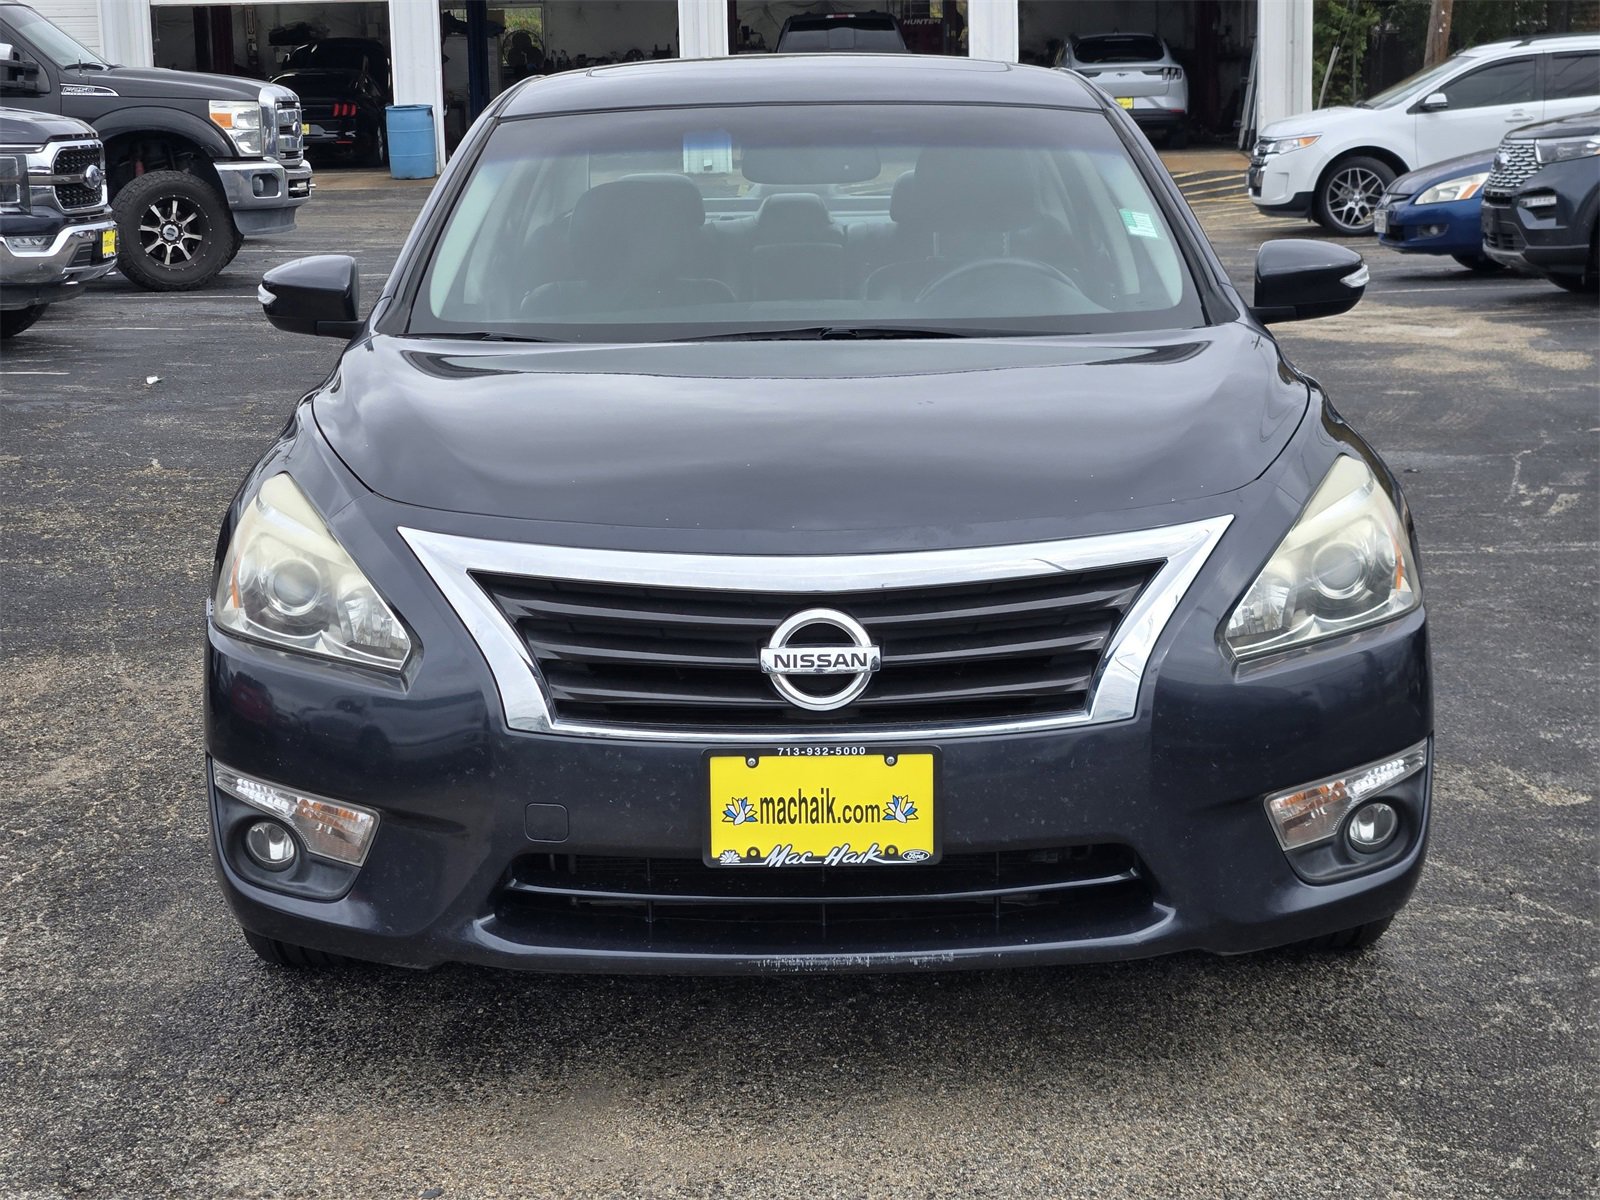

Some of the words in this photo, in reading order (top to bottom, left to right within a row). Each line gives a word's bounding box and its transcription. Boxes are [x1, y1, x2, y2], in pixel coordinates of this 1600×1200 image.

[773, 653, 868, 668] NISSAN
[777, 747, 866, 756] 713-932-5000
[760, 787, 881, 824] machaik.com
[766, 844, 821, 867] Mac
[823, 843, 881, 866] Haik
